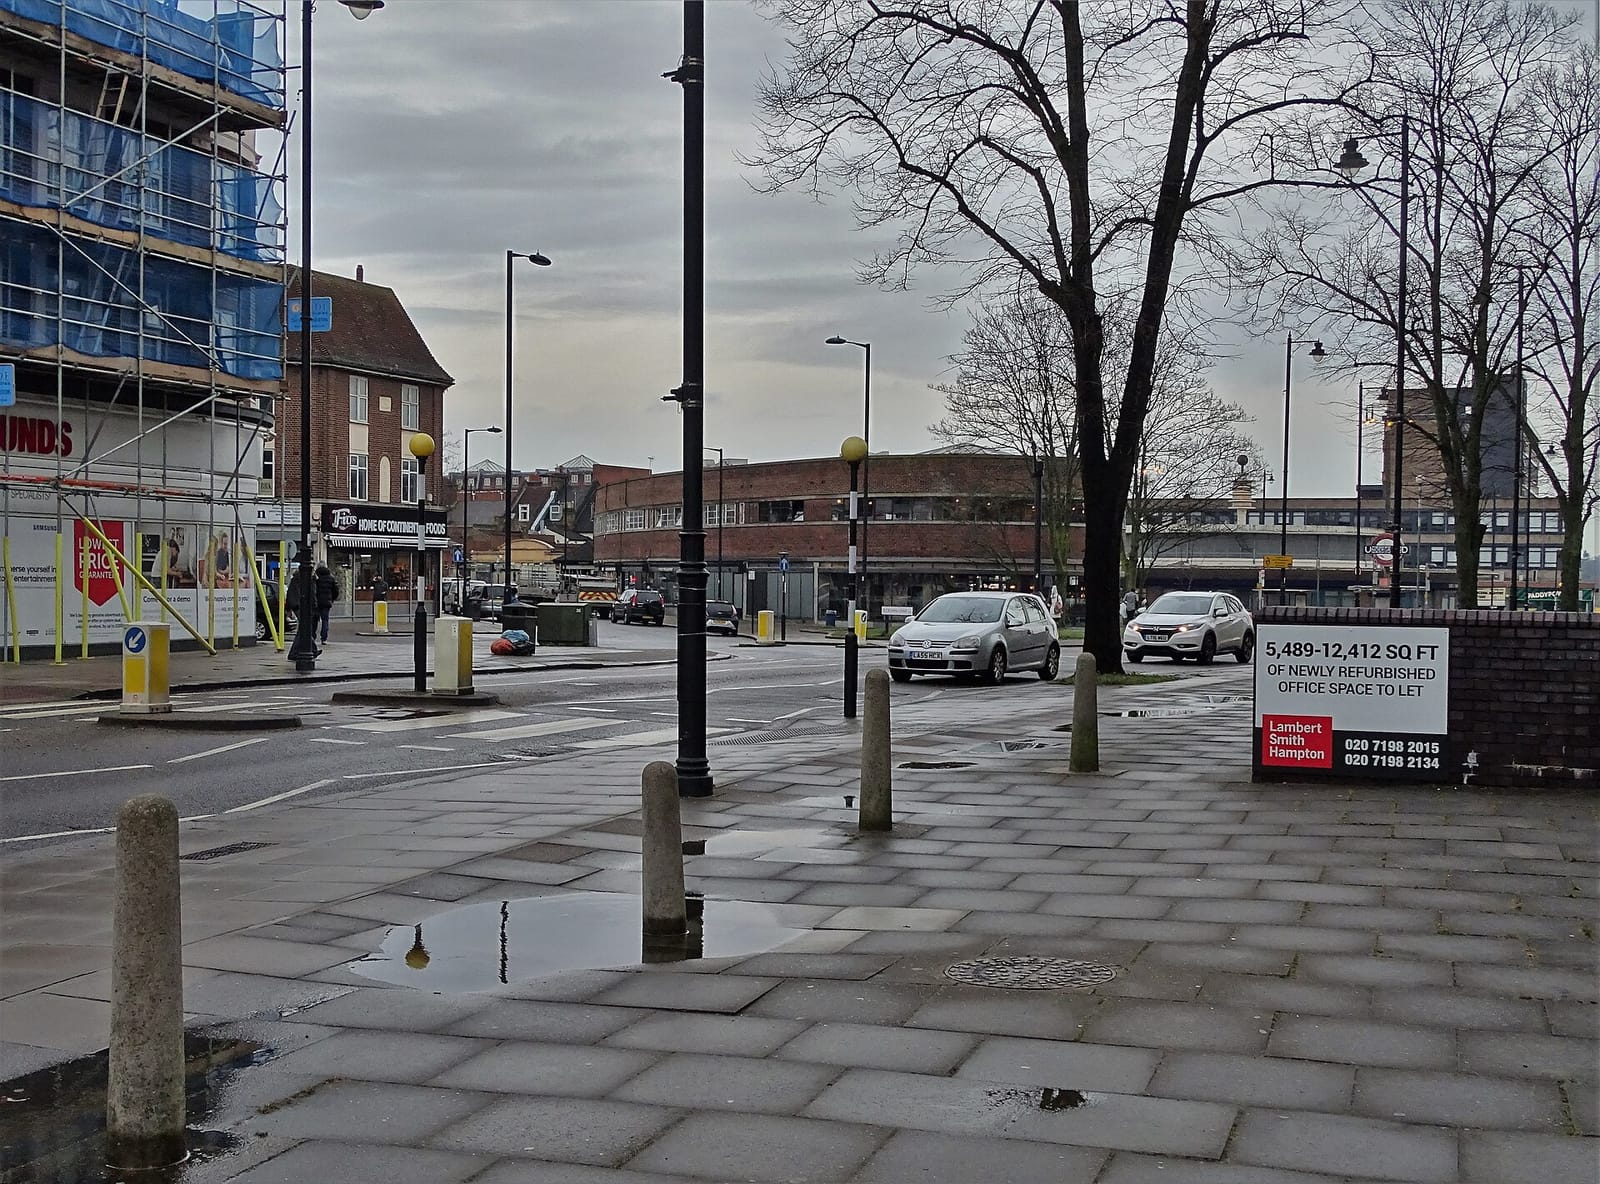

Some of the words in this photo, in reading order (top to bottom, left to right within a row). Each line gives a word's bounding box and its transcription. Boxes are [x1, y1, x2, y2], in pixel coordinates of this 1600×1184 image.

[358, 519, 378, 531] HOME
[378, 519, 388, 532] OF
[425, 522, 446, 534] FOODS
[27, 565, 50, 574] yourself
[177, 595, 191, 603] demo
[1265, 641, 1381, 661] 5,489-12,412
[1386, 644, 1412, 661] SQ
[1417, 645, 1439, 660] FT
[1267, 664, 1286, 675] OF
[1288, 665, 1335, 677] NEWLY
[1338, 666, 1436, 680] REFURBISHED
[1278, 681, 1326, 694] OFFICE
[1328, 683, 1373, 695] SPACE
[1376, 684, 1395, 696] TO
[1398, 685, 1424, 697] LET
[1269, 720, 1323, 734] Lambert
[1269, 733, 1305, 746] Smith
[1344, 738, 1369, 751] 020
[1372, 740, 1404, 752] 7198
[1407, 741, 1440, 754] 2015
[1269, 745, 1325, 761] Hampton
[1344, 754, 1369, 766] 020
[1371, 755, 1404, 767] 7198
[1407, 756, 1440, 769] 2134
